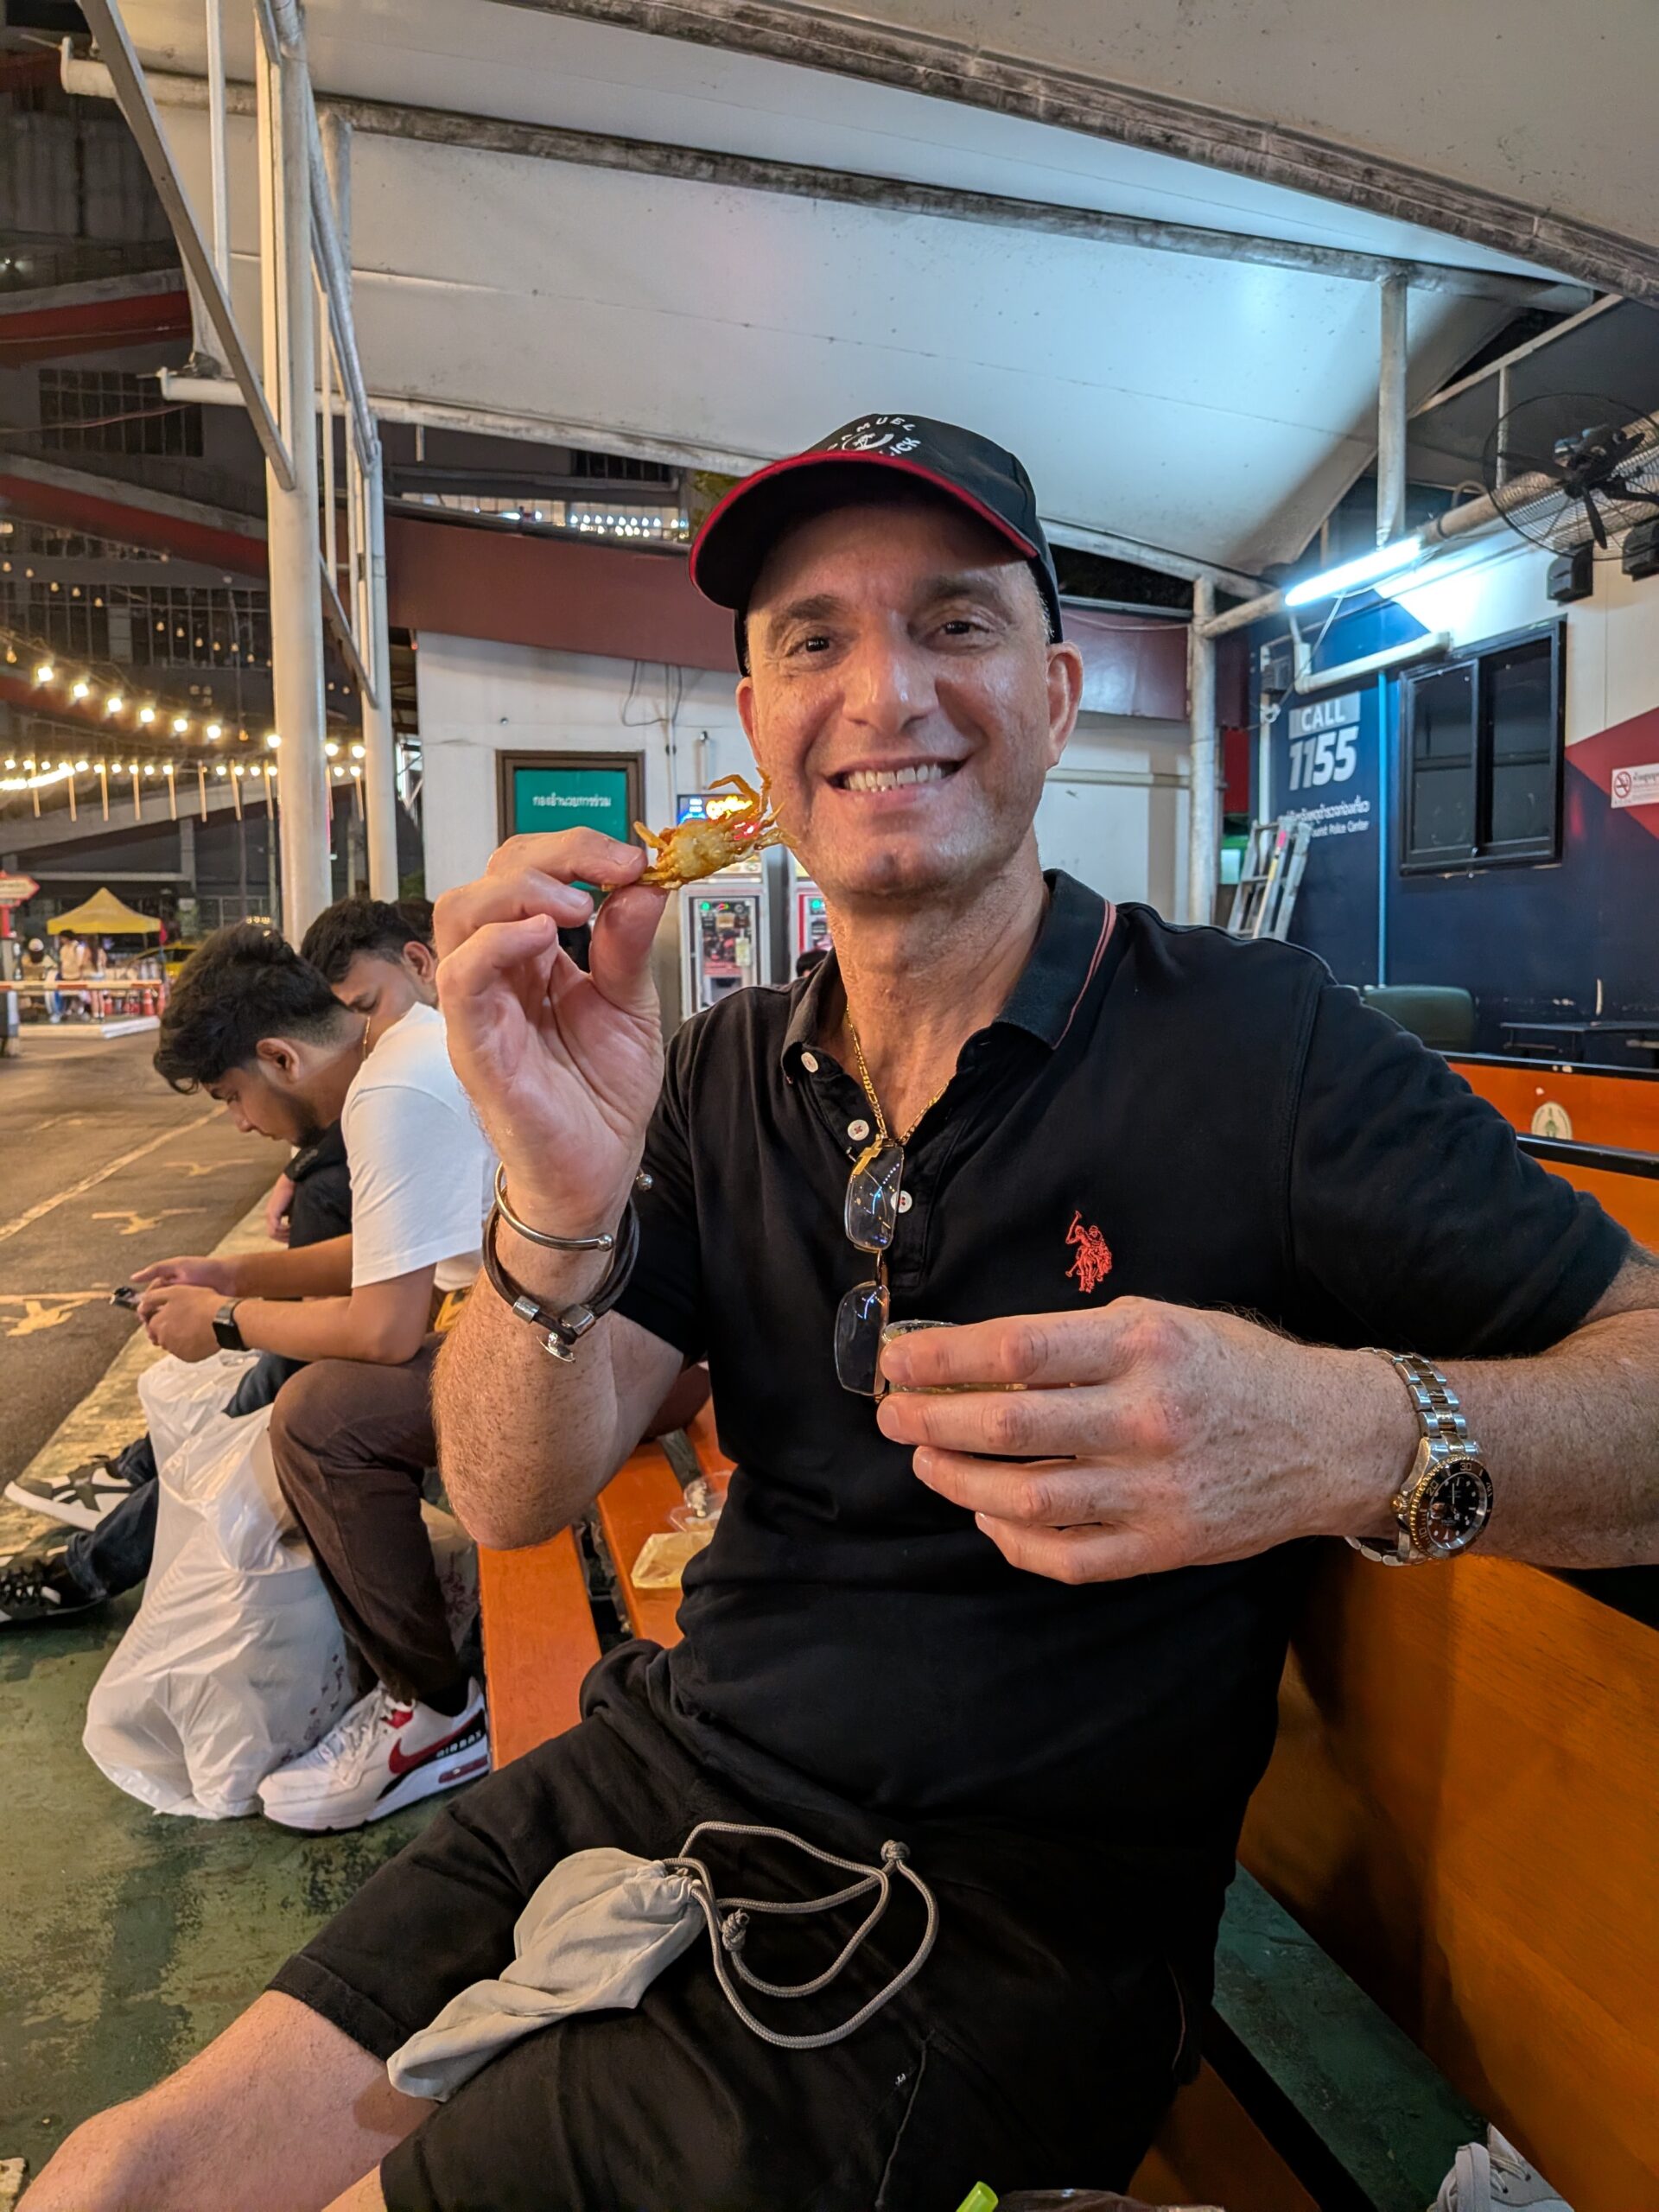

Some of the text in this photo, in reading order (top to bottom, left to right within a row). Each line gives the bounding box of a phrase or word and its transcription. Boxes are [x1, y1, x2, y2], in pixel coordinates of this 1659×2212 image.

[1301, 699, 1345, 731] CALL
[1289, 725, 1359, 791] 1155
[1460, 1462, 1472, 1471] 30
[1426, 1480, 1439, 1496] 20
